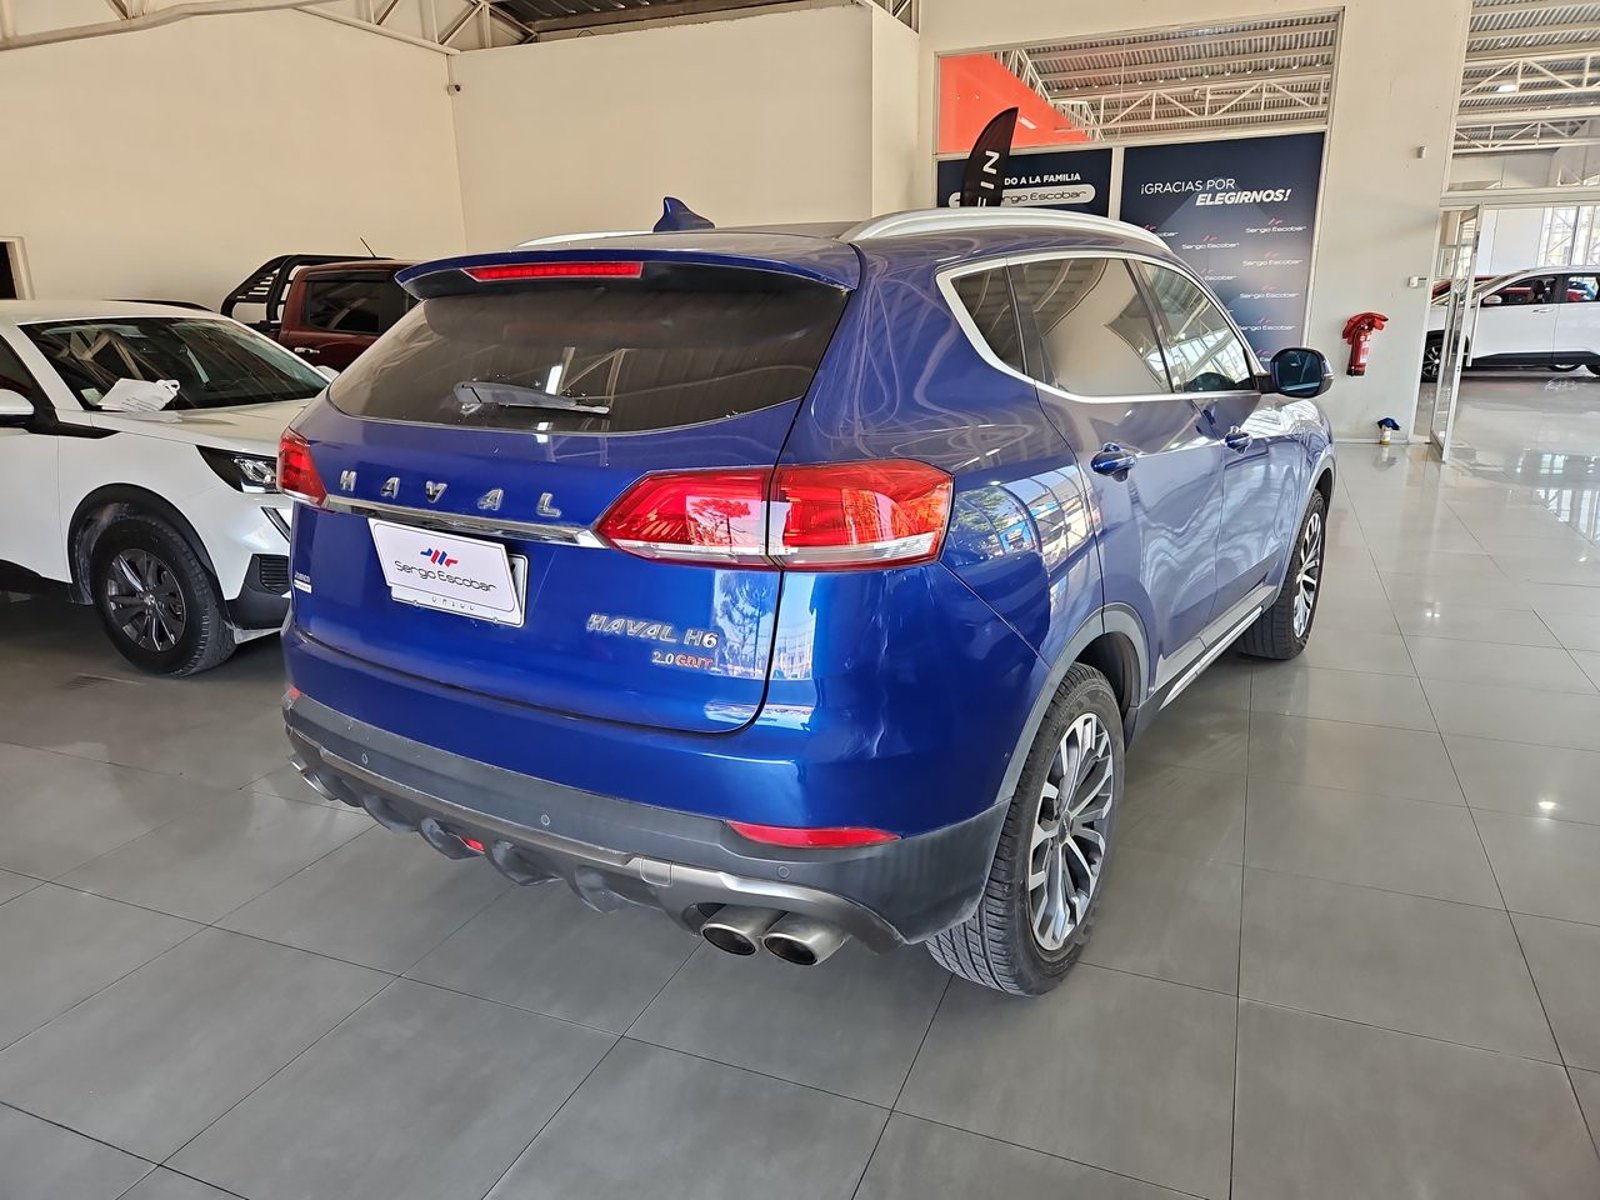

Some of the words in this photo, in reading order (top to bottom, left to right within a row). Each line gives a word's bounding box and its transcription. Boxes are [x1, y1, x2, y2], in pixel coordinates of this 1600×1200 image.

[1004, 177, 1018, 185] DO
[1020, 177, 1027, 185] A
[1029, 175, 1041, 184] LA
[1043, 173, 1081, 183] FAMILIA
[1140, 181, 1203, 195] ¡GRACIAS
[1206, 178, 1236, 191] POR
[1030, 191, 1087, 201] Escobar
[1195, 188, 1292, 206] ELEGIRNOS!
[339, 469, 562, 518] HAVAL
[437, 570, 497, 592] Escobar
[586, 613, 677, 644] HAVAL
[684, 628, 719, 648] H6
